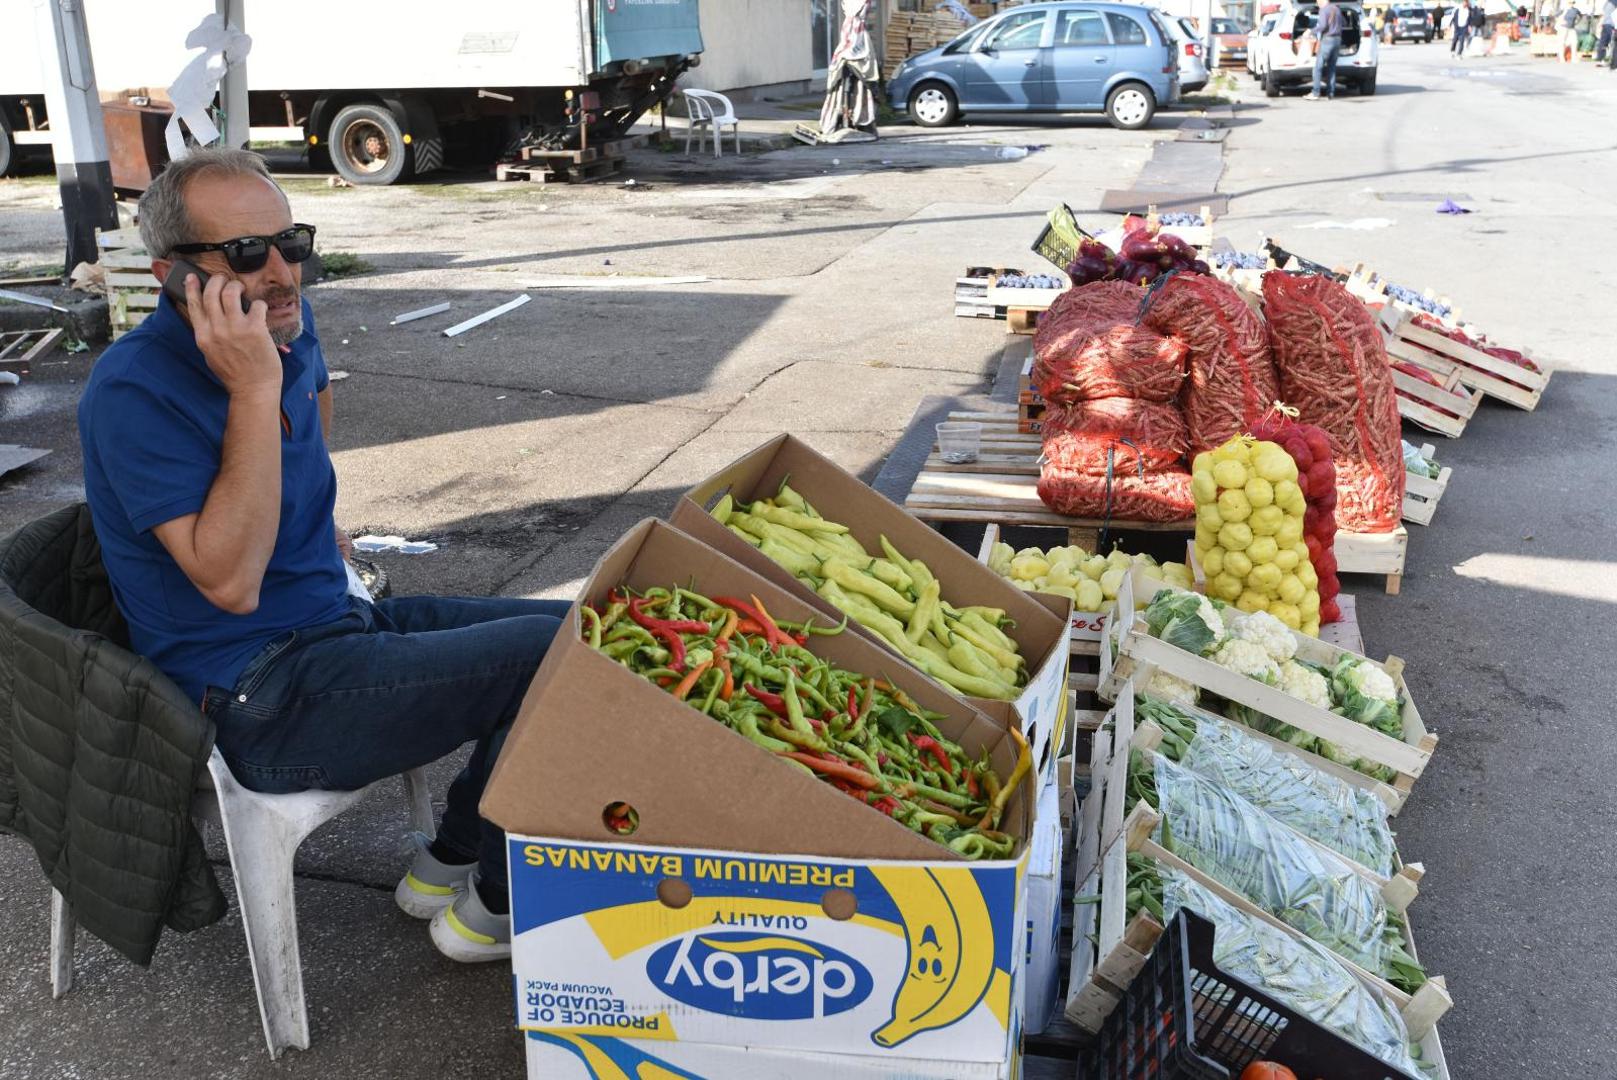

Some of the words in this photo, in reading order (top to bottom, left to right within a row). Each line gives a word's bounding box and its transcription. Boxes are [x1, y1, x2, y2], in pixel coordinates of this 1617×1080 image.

[525, 845, 683, 877] BANANAS
[694, 858, 855, 887] PREMIUM
[712, 910, 808, 931] QUALITY
[526, 980, 559, 991] PACK
[664, 934, 856, 1021] derby
[563, 982, 614, 996] VACUUM
[527, 992, 625, 1013] ECUADOR
[527, 1008, 555, 1023] OF
[561, 1010, 660, 1030] PRODUCE
